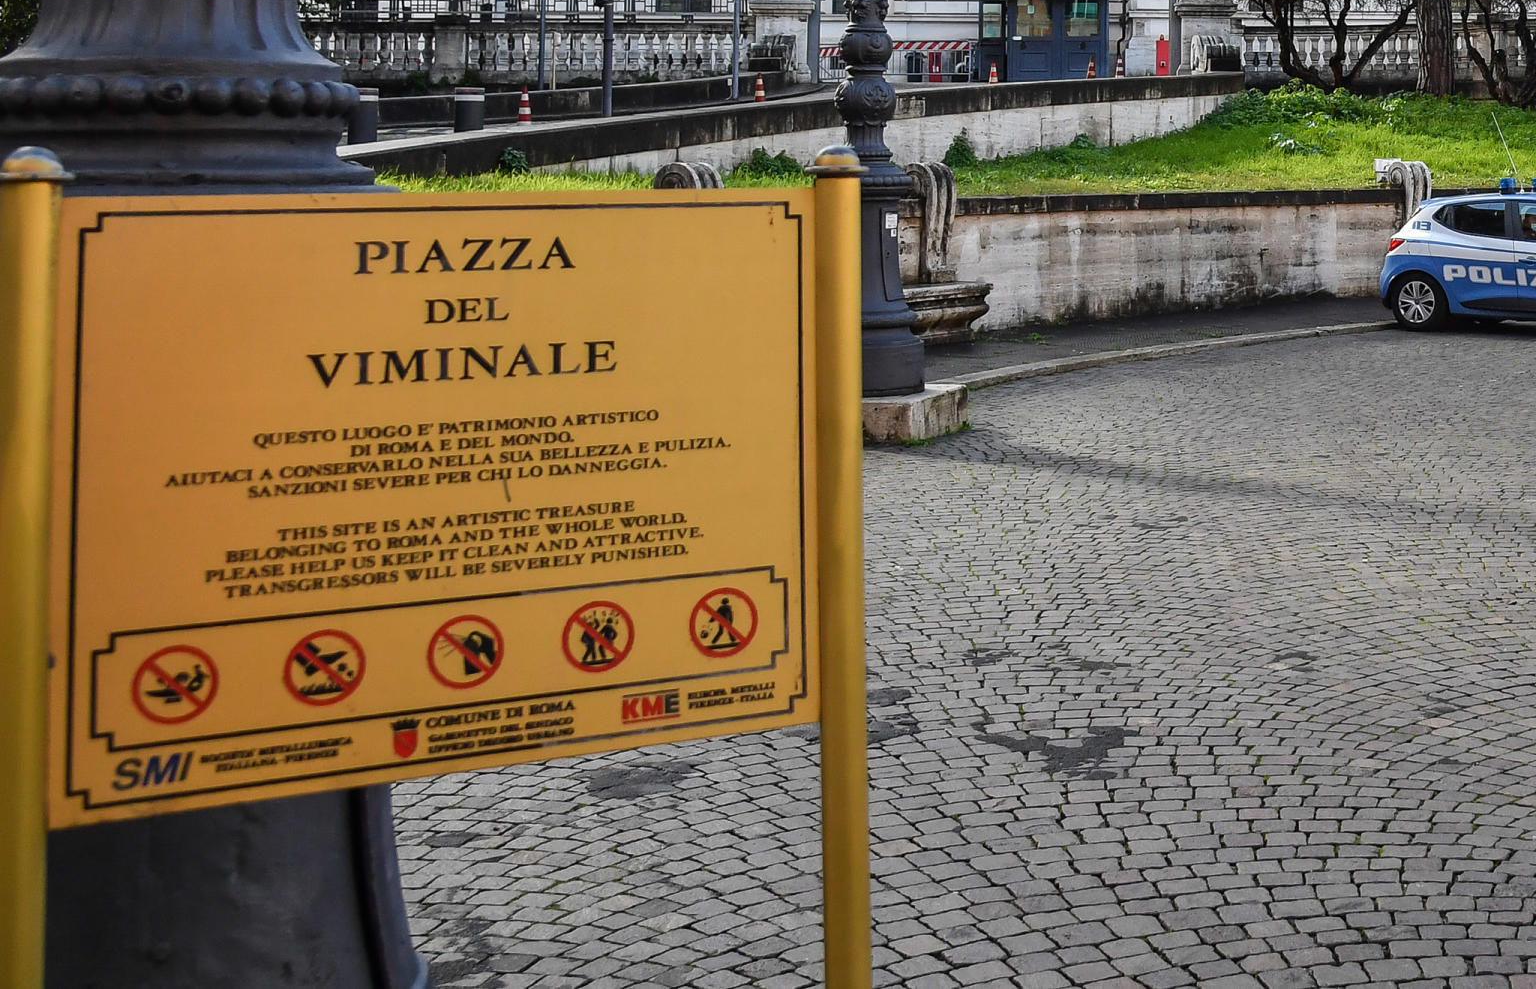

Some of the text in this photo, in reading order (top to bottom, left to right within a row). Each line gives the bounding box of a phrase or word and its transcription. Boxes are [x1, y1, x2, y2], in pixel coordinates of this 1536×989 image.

[1412, 221, 1431, 231] 113
[354, 236, 576, 275] PIAZZA
[424, 297, 510, 324] DEL
[306, 340, 618, 389] VIMINALE
[253, 428, 337, 449] QUESTO
[342, 424, 412, 441] LUOGO
[439, 415, 557, 434] PATRIMONIO
[563, 409, 659, 427] ARTISTICO
[350, 431, 575, 458] DI ROMA E DEL MONDO.
[165, 436, 731, 488] AIUTACI A CONSERVARLO NELLA SUA BELLEZZA E PULIZIA.
[248, 458, 668, 499] SANZIONI SEVERE PER CHI LO DANNEGGIA.
[225, 512, 688, 563] BELONGING TO ROMA AND THE WHOLE WORLD.
[277, 500, 635, 541] THIS SITE IS AN ARTISTIC TREASURE
[204, 526, 705, 583] PLEASE HELP US KEEP IT CLEAN AND ATTRACTIVE.
[224, 543, 689, 599] TRANSGRESSORS WILL BE SEVERELY PUNISHED.
[425, 699, 576, 729] COMUNE DI ROMA
[622, 694, 680, 719] KME
[112, 751, 194, 791] SMI
